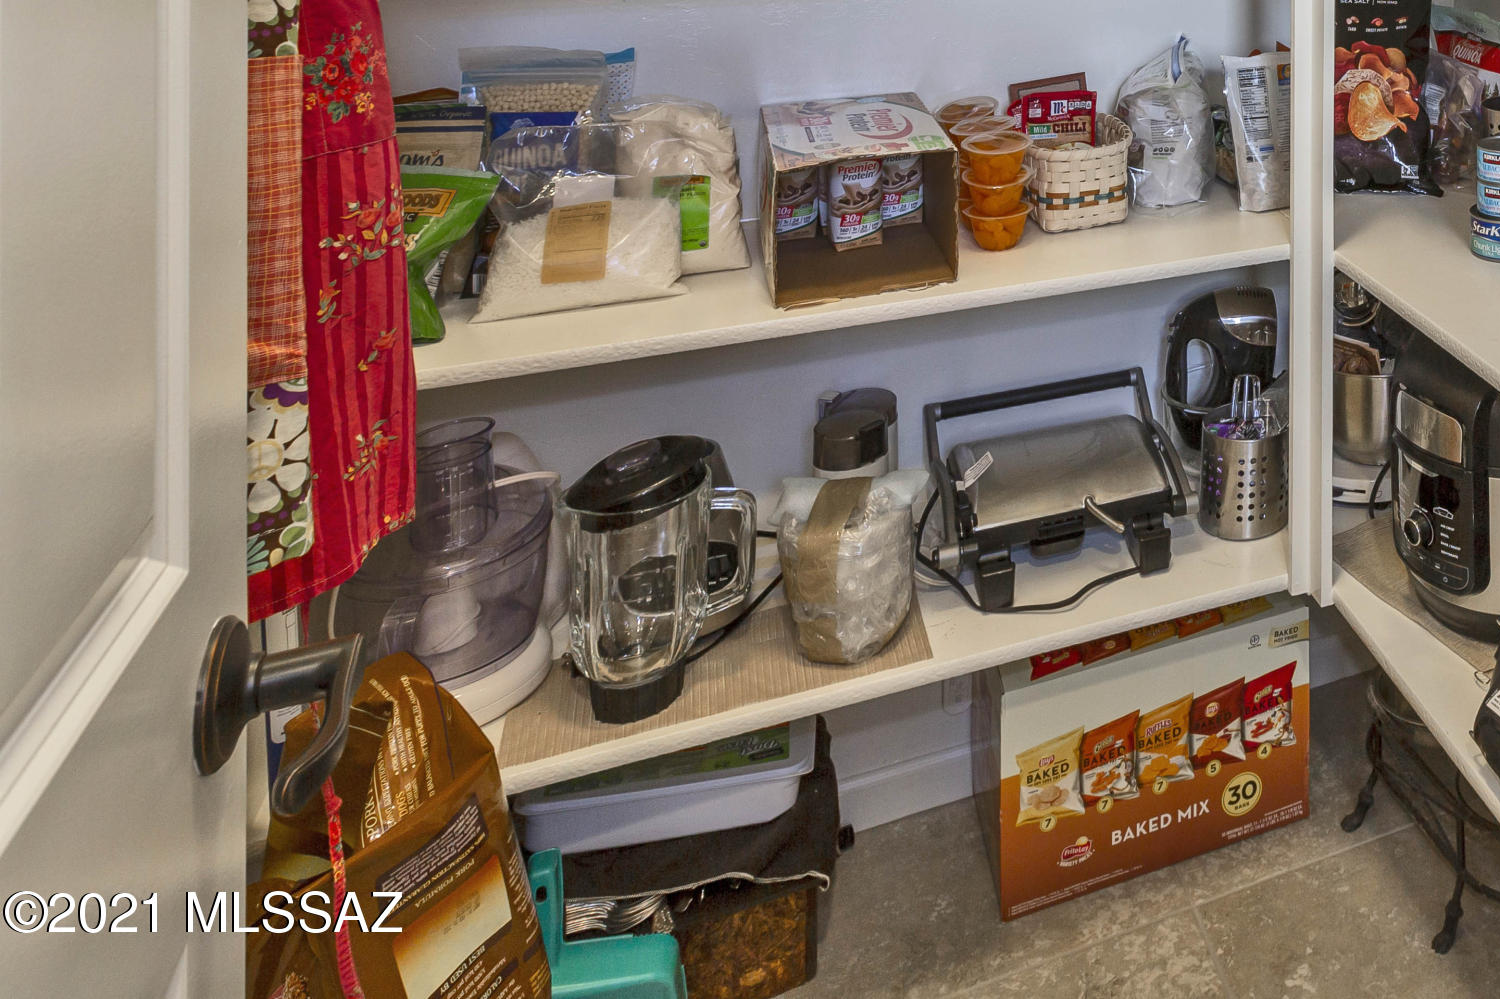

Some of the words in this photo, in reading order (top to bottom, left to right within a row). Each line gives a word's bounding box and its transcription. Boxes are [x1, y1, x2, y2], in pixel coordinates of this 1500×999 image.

[1453, 44, 1484, 65] QUINOA
[1033, 126, 1048, 134] Mild
[1053, 121, 1087, 133] CHILI
[838, 163, 877, 175] Premier
[842, 171, 876, 181] Protein
[844, 216, 860, 225] 30g
[1273, 626, 1299, 638] BAKED
[1138, 726, 1182, 750] BAKED
[1082, 744, 1127, 768] BAKED
[1026, 761, 1070, 785] BAKED
[1227, 779, 1258, 806] 30
[1111, 814, 1173, 846] BAKED
[1178, 799, 1210, 827] MIX
